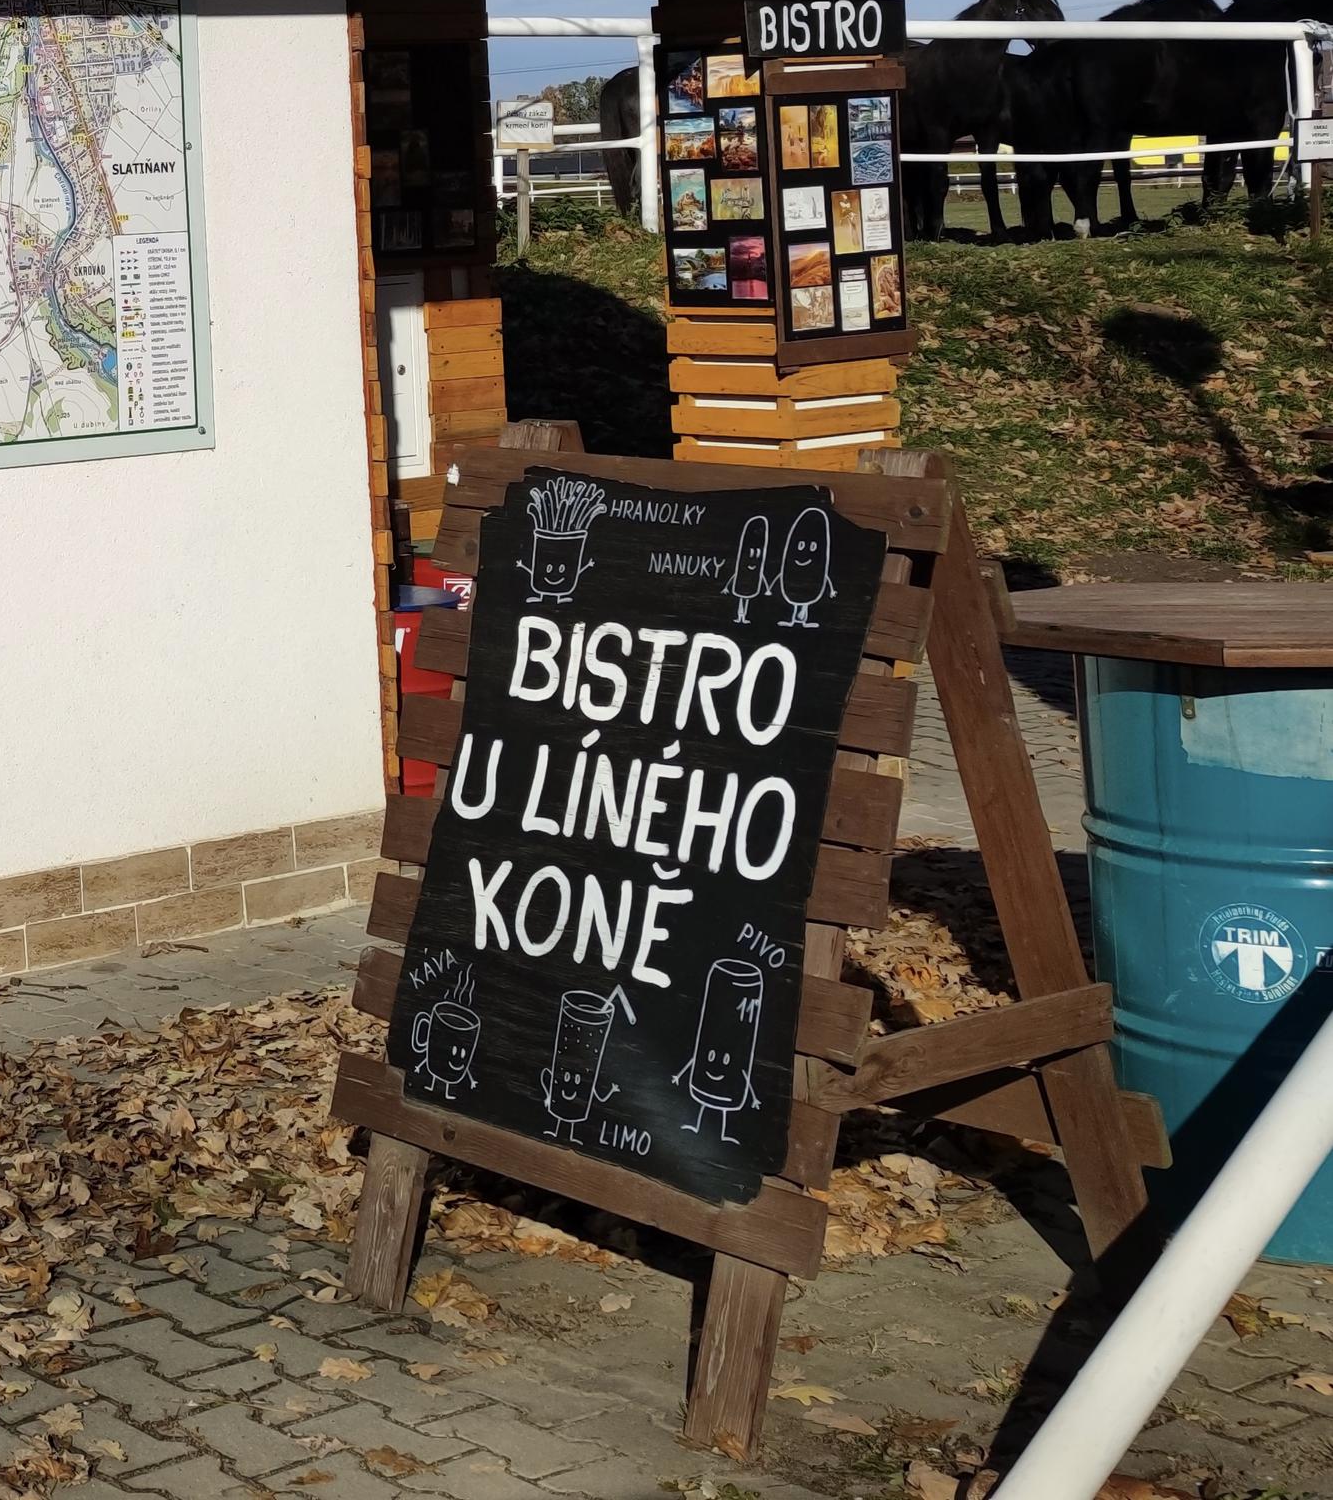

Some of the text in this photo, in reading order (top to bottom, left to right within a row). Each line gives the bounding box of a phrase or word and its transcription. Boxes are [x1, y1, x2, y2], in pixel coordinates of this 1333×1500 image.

[759, 0, 883, 52] BISTRO
[112, 159, 175, 175] SLATIŇANY
[609, 499, 706, 526] HRANOLKY
[648, 552, 726, 579] NANUKY
[510, 616, 799, 747] BISTRO
[451, 730, 797, 882] U LÍNÉHO
[469, 858, 694, 987] KONĚ
[1223, 926, 1280, 946] TRIM
[737, 923, 786, 969] PIVO
[409, 947, 459, 990] KÁVA
[600, 1120, 652, 1156] LIMO
